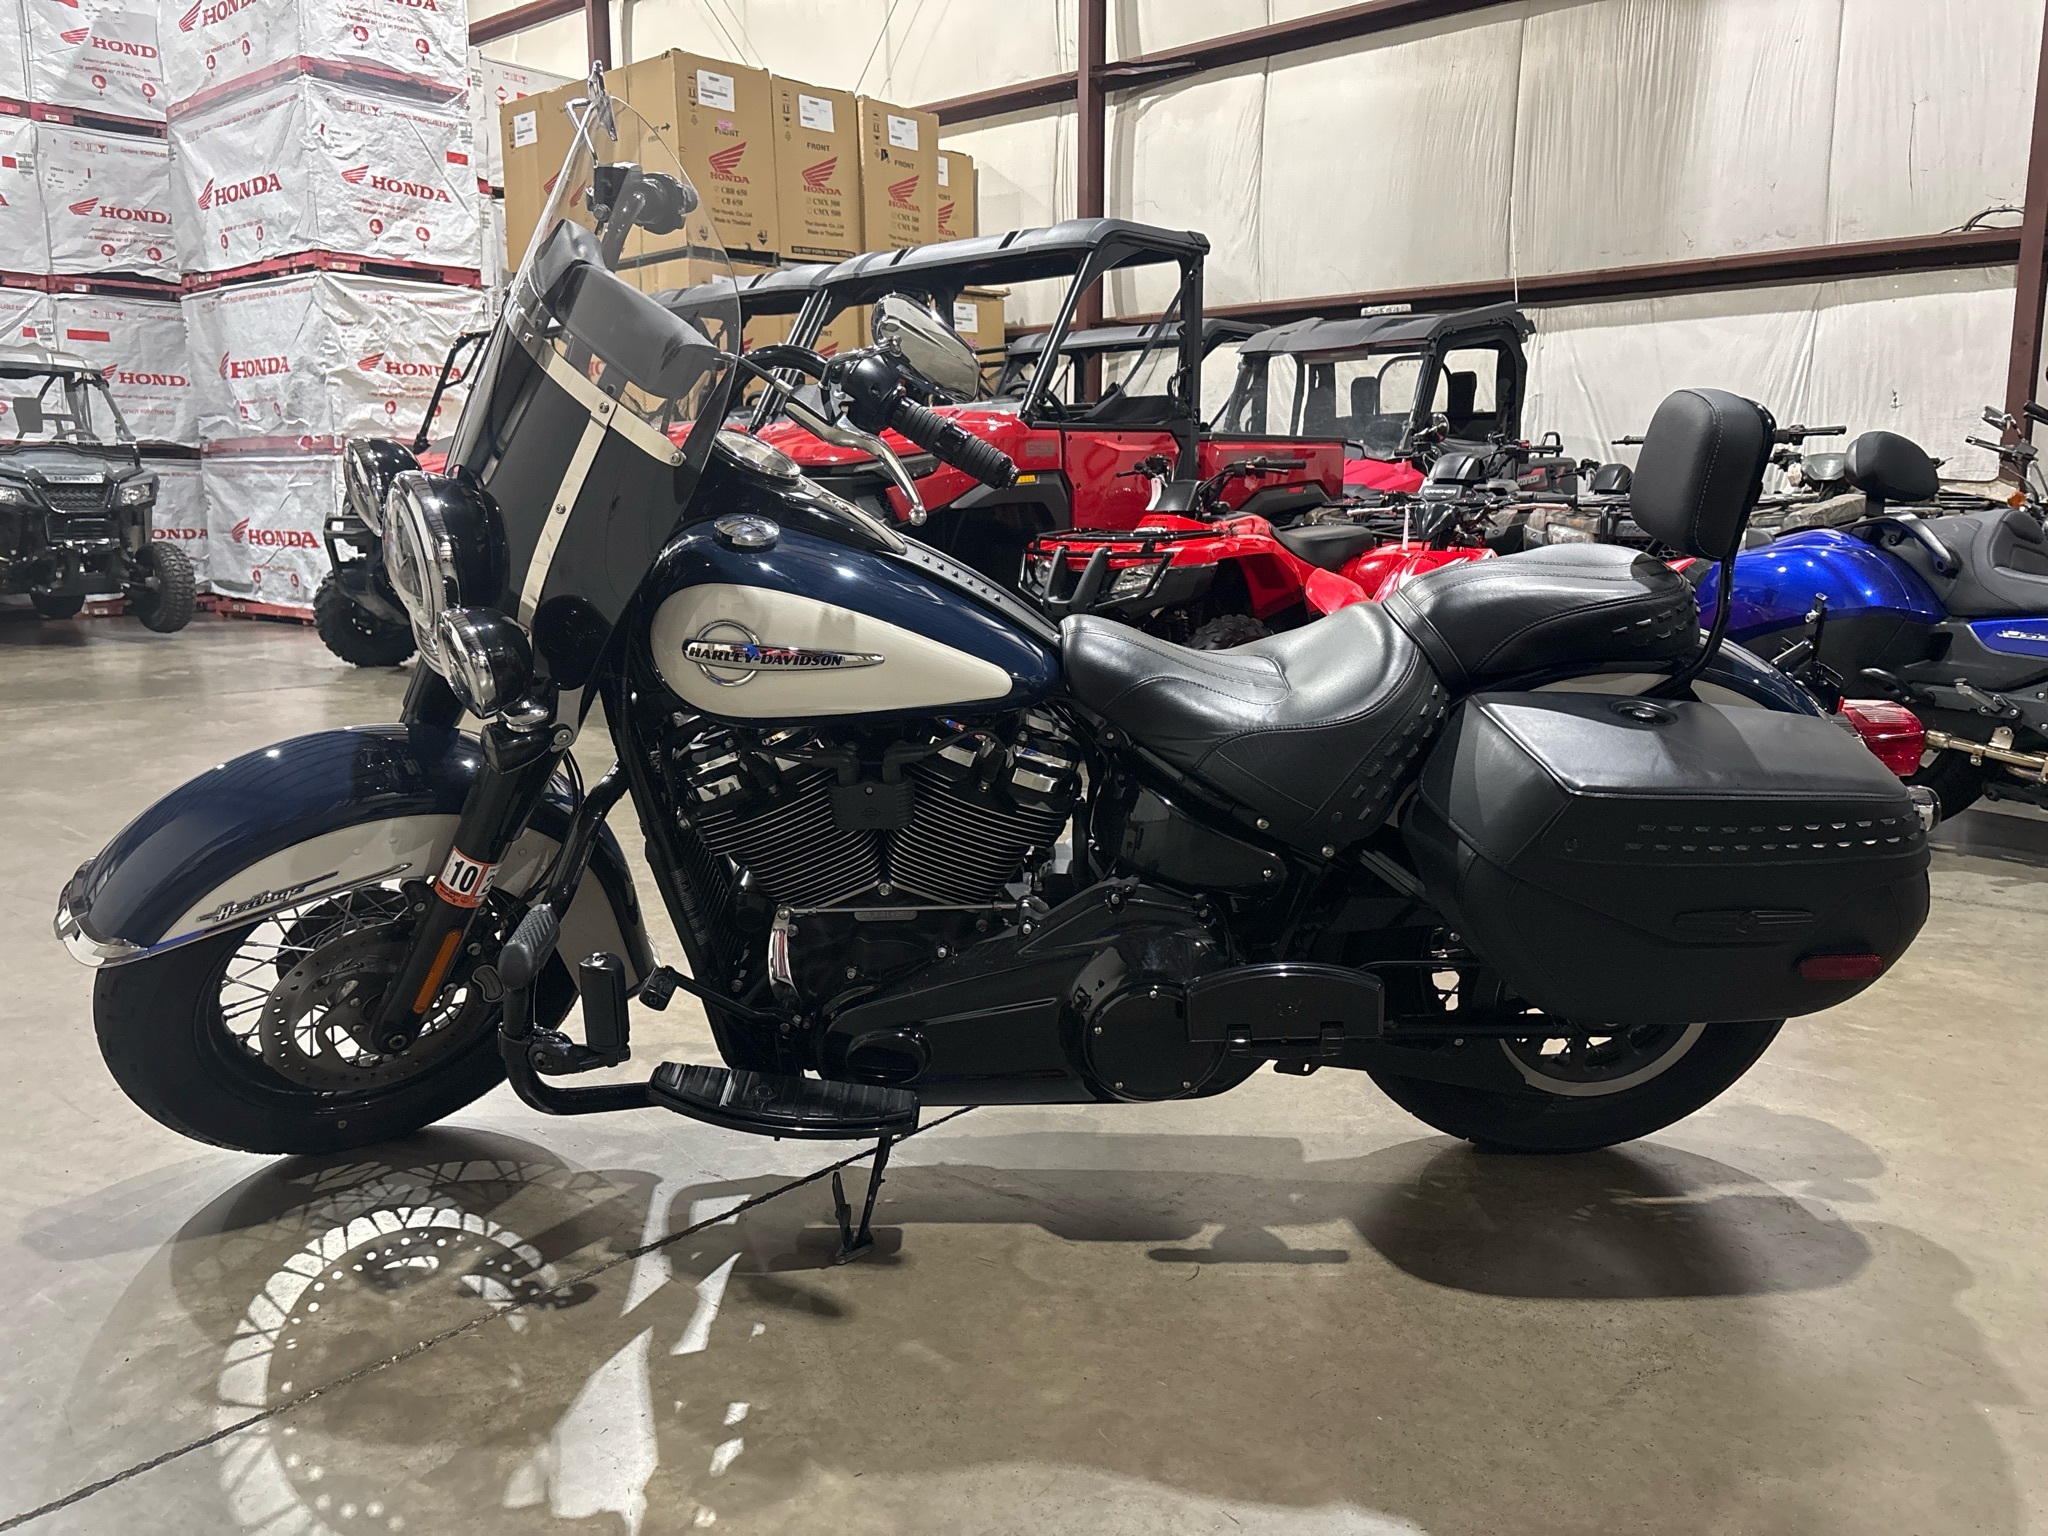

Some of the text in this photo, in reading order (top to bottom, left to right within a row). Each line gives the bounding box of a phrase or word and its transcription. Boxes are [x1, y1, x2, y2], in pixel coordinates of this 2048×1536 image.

[807, 142, 830, 152] FRONT
[895, 160, 915, 170] FRONT
[710, 171, 750, 184] HONDA
[215, 173, 282, 206] HONDA
[371, 175, 452, 203] HONDA
[803, 185, 842, 196] HONDA
[813, 198, 829, 206] CMX
[888, 199, 921, 213] HONDA
[813, 208, 830, 217] CMX
[230, 356, 291, 379] HONDA
[119, 372, 191, 387] HOND
[249, 528, 320, 549] HONDA
[689, 647, 842, 667] HARLEY-DAVIDSON
[449, 860, 479, 893] 10
